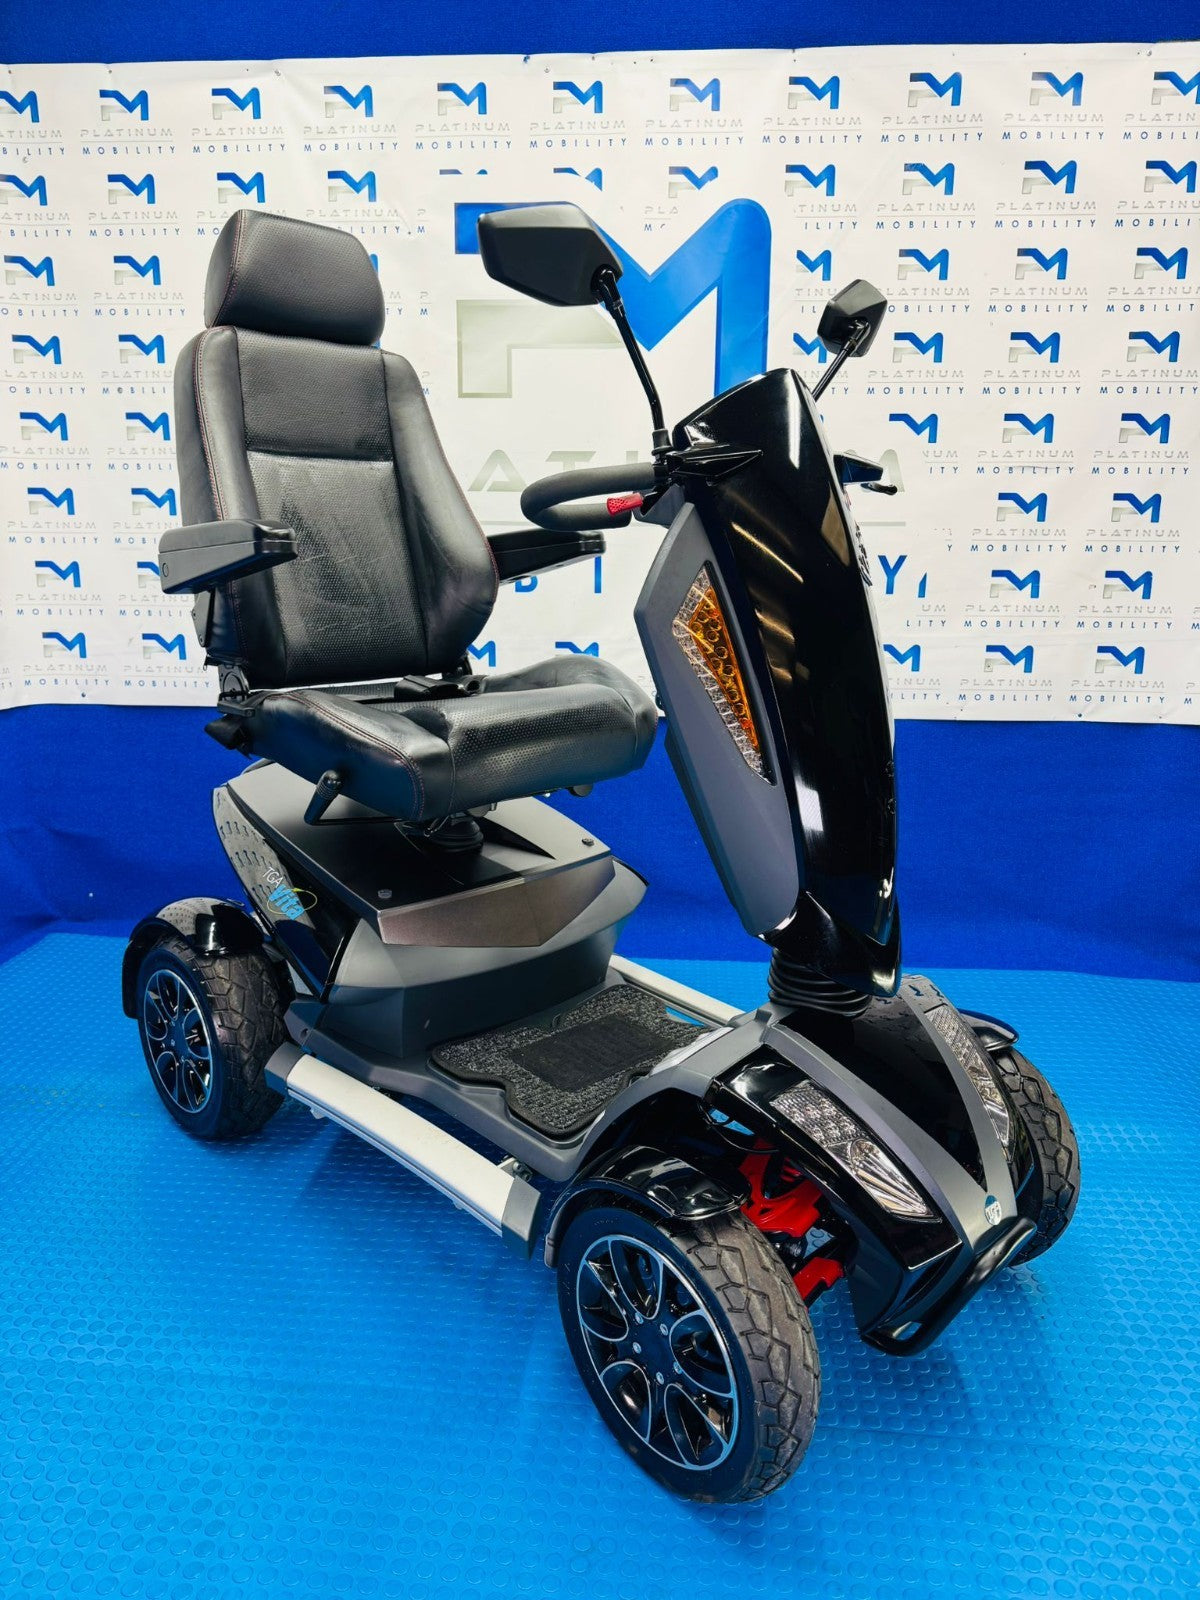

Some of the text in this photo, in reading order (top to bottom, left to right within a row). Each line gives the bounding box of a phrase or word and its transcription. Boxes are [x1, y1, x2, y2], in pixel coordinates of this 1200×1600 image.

[763, 116, 862, 125] PLATINUM
[881, 113, 983, 124] PLATINUM
[1003, 113, 1104, 123] PLATINUM
[1125, 113, 1197, 122] PLATIN
[415, 122, 510, 132] PLATINUM
[530, 120, 625, 130] PLATINUM
[645, 118, 742, 128] PLATINUM
[81, 128, 173, 137] PLATINUM
[192, 126, 284, 136] PLATINUM
[304, 125, 397, 134] PLATINUM
[763, 135, 861, 143] MOBILITY
[881, 132, 983, 142] MOBILITY
[1002, 131, 1104, 140] MOBILITY
[1123, 131, 1200, 140] MOBILI
[530, 138, 626, 148] MOBILITY
[645, 136, 743, 145] MOBILITY
[193, 144, 285, 153] MOBILITY
[304, 142, 398, 151] MOBILITY
[416, 141, 511, 150] MOBILITY
[3, 147, 65, 155] BILITY
[83, 147, 175, 155] MOBILITY
[877, 203, 976, 212] PLATINUM
[996, 201, 1096, 211] PLATINUM
[0, 212, 70, 221] ATINUM
[89, 211, 178, 220] PLATINUM
[306, 209, 398, 218] PLATINUM
[876, 221, 975, 229] MOBILITY
[995, 220, 1096, 228] MOBILITY
[1115, 218, 1189, 227] MOBILI
[11, 229, 71, 237] BILITY
[90, 228, 180, 237] MOBILITY
[94, 291, 184, 300] PLATINUM
[886, 288, 970, 296] LATINUM
[989, 287, 1088, 296] PLATINUM
[1108, 286, 1196, 296] PLATINU
[5, 292, 77, 301] ATINUM
[1, 308, 78, 316] OBILITY
[888, 305, 970, 313] OBILITY
[989, 305, 1087, 313] MOBILITY
[1107, 304, 1195, 312] MOBILIT
[5, 370, 84, 379] LATINUM
[102, 370, 172, 378] PLATINU
[868, 370, 964, 378] PLATINUM
[984, 369, 1080, 378] PLATINUM
[1102, 369, 1198, 378] PLATINUM
[868, 387, 963, 395] MOBILITY
[982, 386, 1081, 395] MOBILITY
[1100, 386, 1198, 394] MOBILITY
[977, 450, 1074, 458] PLATINUM
[1093, 450, 1189, 459] PLATINUM
[1, 462, 91, 470] MOBILITY
[976, 466, 1073, 474] MOBILITY
[1092, 467, 1189, 475] MOBILITY
[971, 528, 1066, 537] PLATINUM
[1086, 529, 1180, 537] PLATINUM
[9, 536, 97, 544] MOBILITY
[971, 544, 1066, 552] MOBILITY
[1085, 544, 1179, 553] MOBILITY
[17, 608, 103, 616] MOBILITY
[965, 604, 1060, 613] PLATINUM
[1079, 605, 1172, 614] PLATINUM
[964, 620, 1060, 628] MOBILITY
[1077, 620, 1172, 629] MOBILITY
[124, 679, 213, 687] MOBILITY
[960, 678, 1052, 687] PLATINUM
[1072, 680, 1165, 689] PLATINUM
[959, 693, 1052, 701] MOBILITY
[1070, 694, 1164, 703] MOBILITY
[262, 867, 284, 886] TGA
[269, 884, 304, 920] Vita
